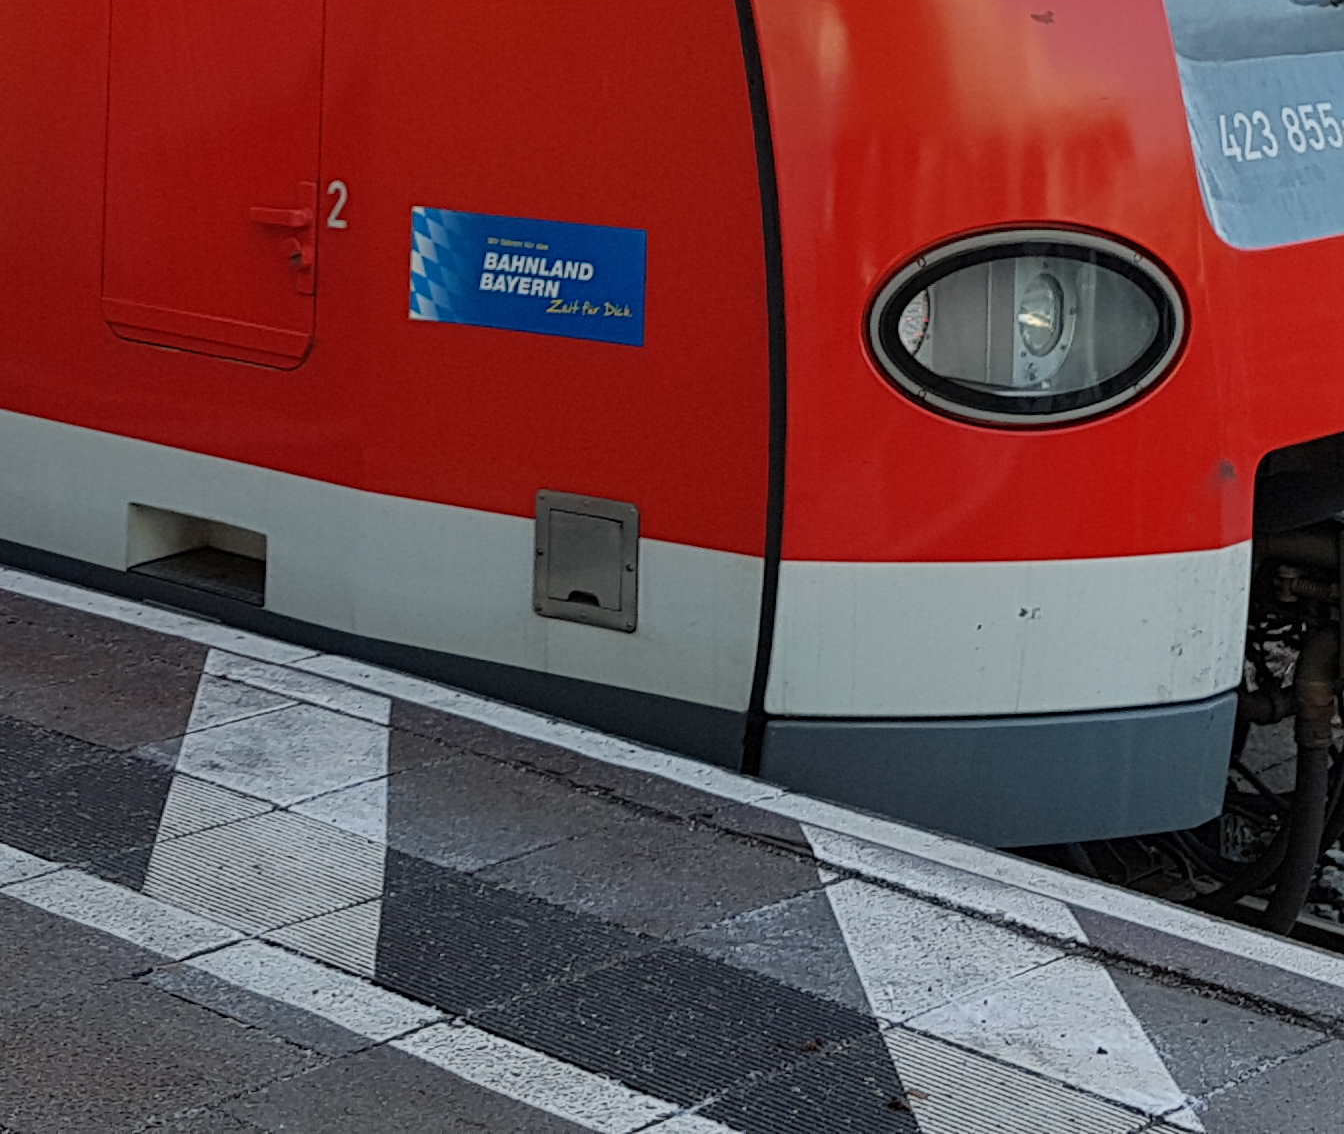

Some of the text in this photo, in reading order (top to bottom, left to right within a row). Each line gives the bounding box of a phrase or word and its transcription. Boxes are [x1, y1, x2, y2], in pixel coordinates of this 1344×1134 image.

[1218, 109, 1280, 163] 423
[326, 178, 349, 229] 2
[479, 272, 561, 299] BAYERN
[483, 251, 594, 282] BAHNLAND
